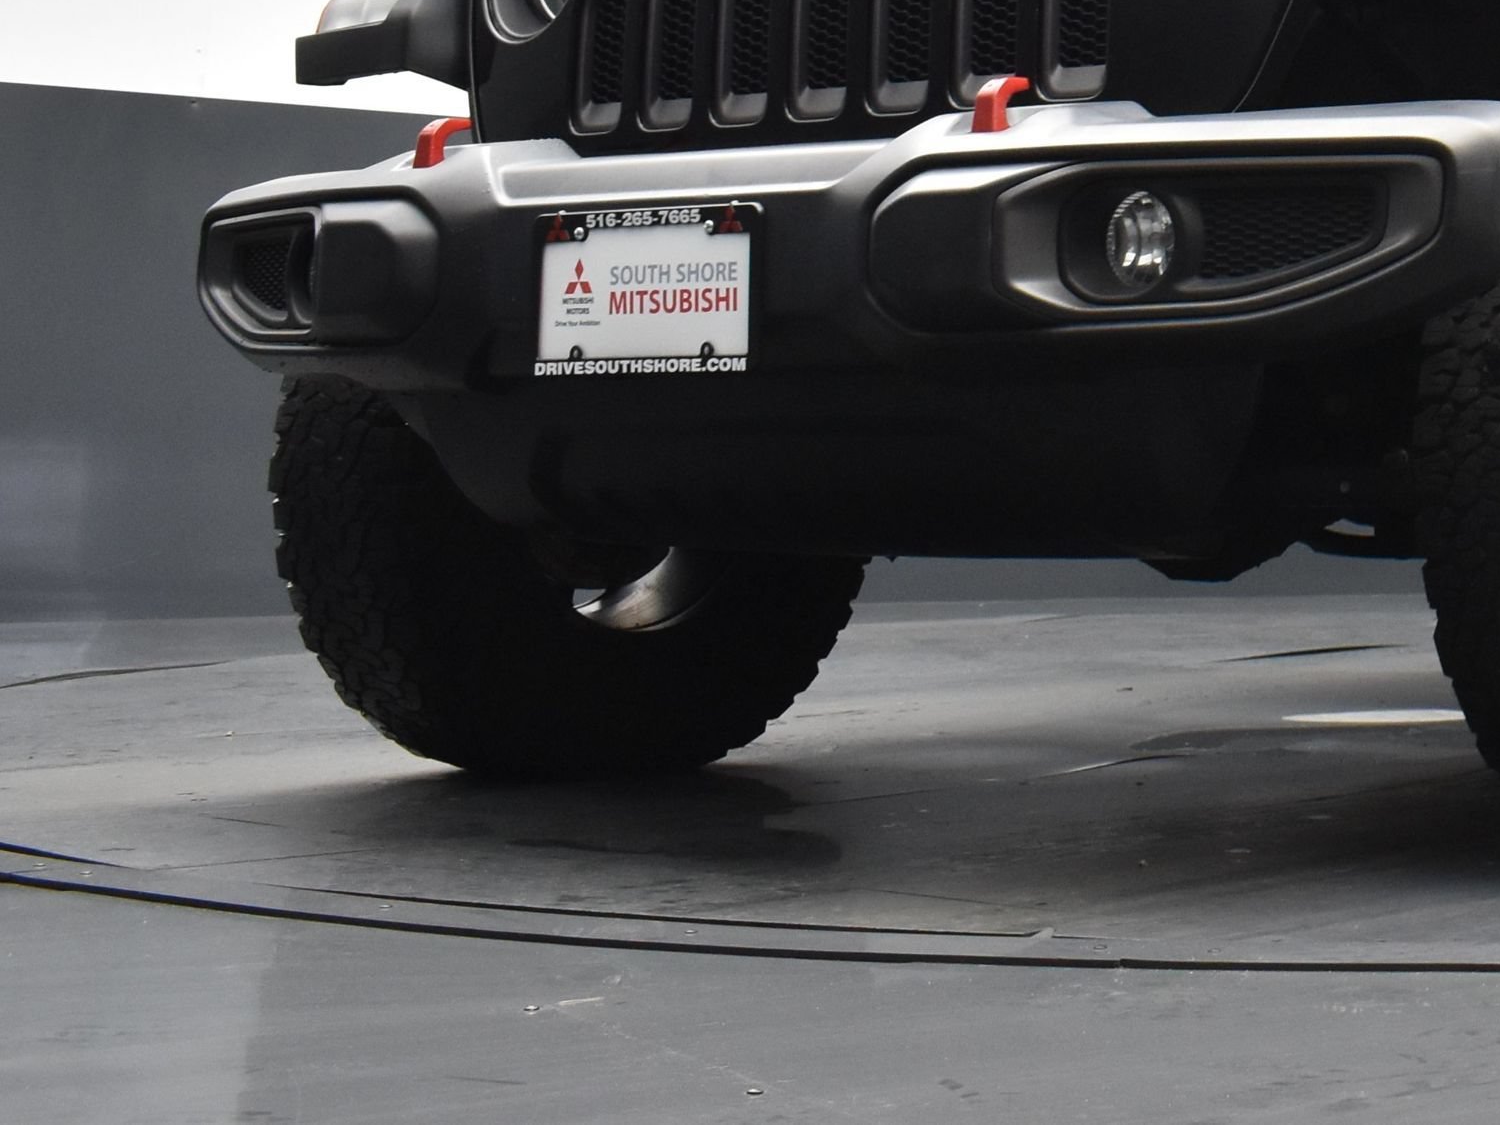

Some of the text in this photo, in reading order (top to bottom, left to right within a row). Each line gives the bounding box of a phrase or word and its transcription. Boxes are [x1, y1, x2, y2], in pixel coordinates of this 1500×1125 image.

[585, 208, 701, 229] 516-265-7665
[609, 261, 738, 286] SOUTH SHORE
[562, 297, 594, 305] MITSUBISHI
[566, 307, 590, 315] MOTORS
[608, 287, 738, 315] MITSUBISHI
[534, 357, 748, 376] DRIVESOUTHSHORE.COM
